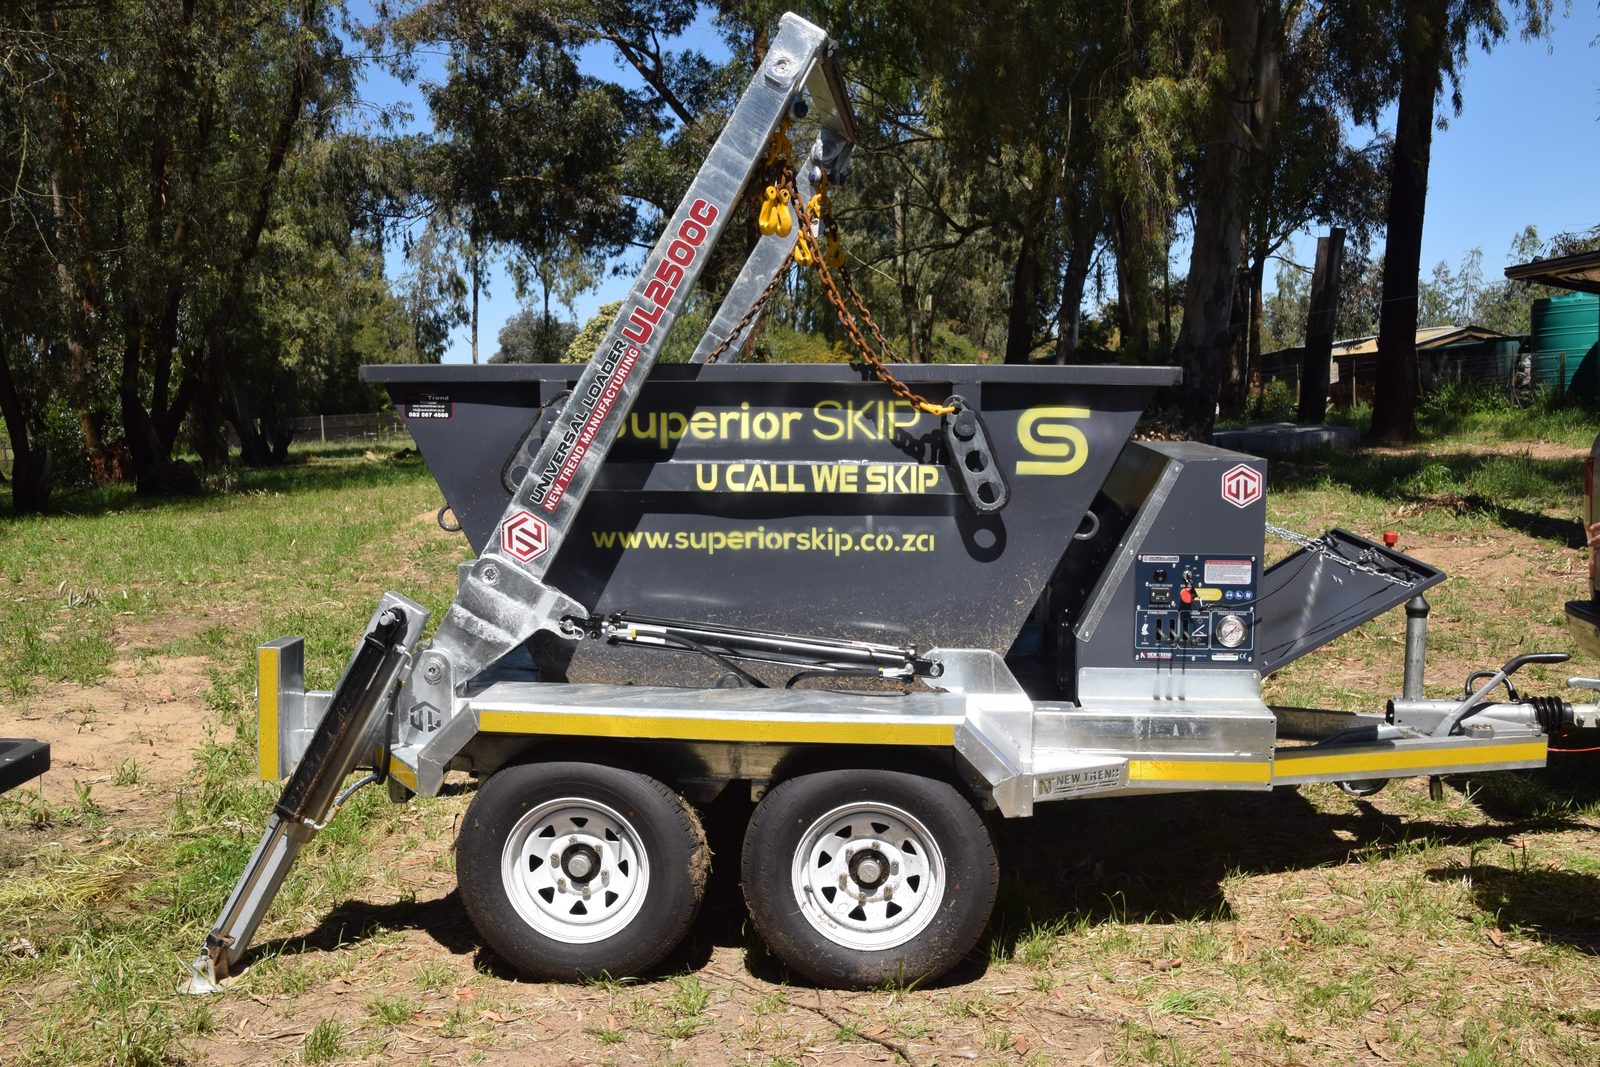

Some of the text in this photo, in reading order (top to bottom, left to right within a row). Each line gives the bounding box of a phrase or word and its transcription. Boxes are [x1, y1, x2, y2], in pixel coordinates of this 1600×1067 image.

[623, 198, 720, 345] UL2500C
[530, 339, 628, 504] UNIVERSAL LOADER
[544, 348, 639, 510] NEW TREND MANUFACTURING
[617, 400, 921, 449] uperior SKIP
[696, 464, 939, 494] U CALL WE SKIP
[592, 526, 935, 557] www.superiorskip.co.za
[1056, 774, 1080, 785] NEW
[1084, 768, 1120, 782] TREND
